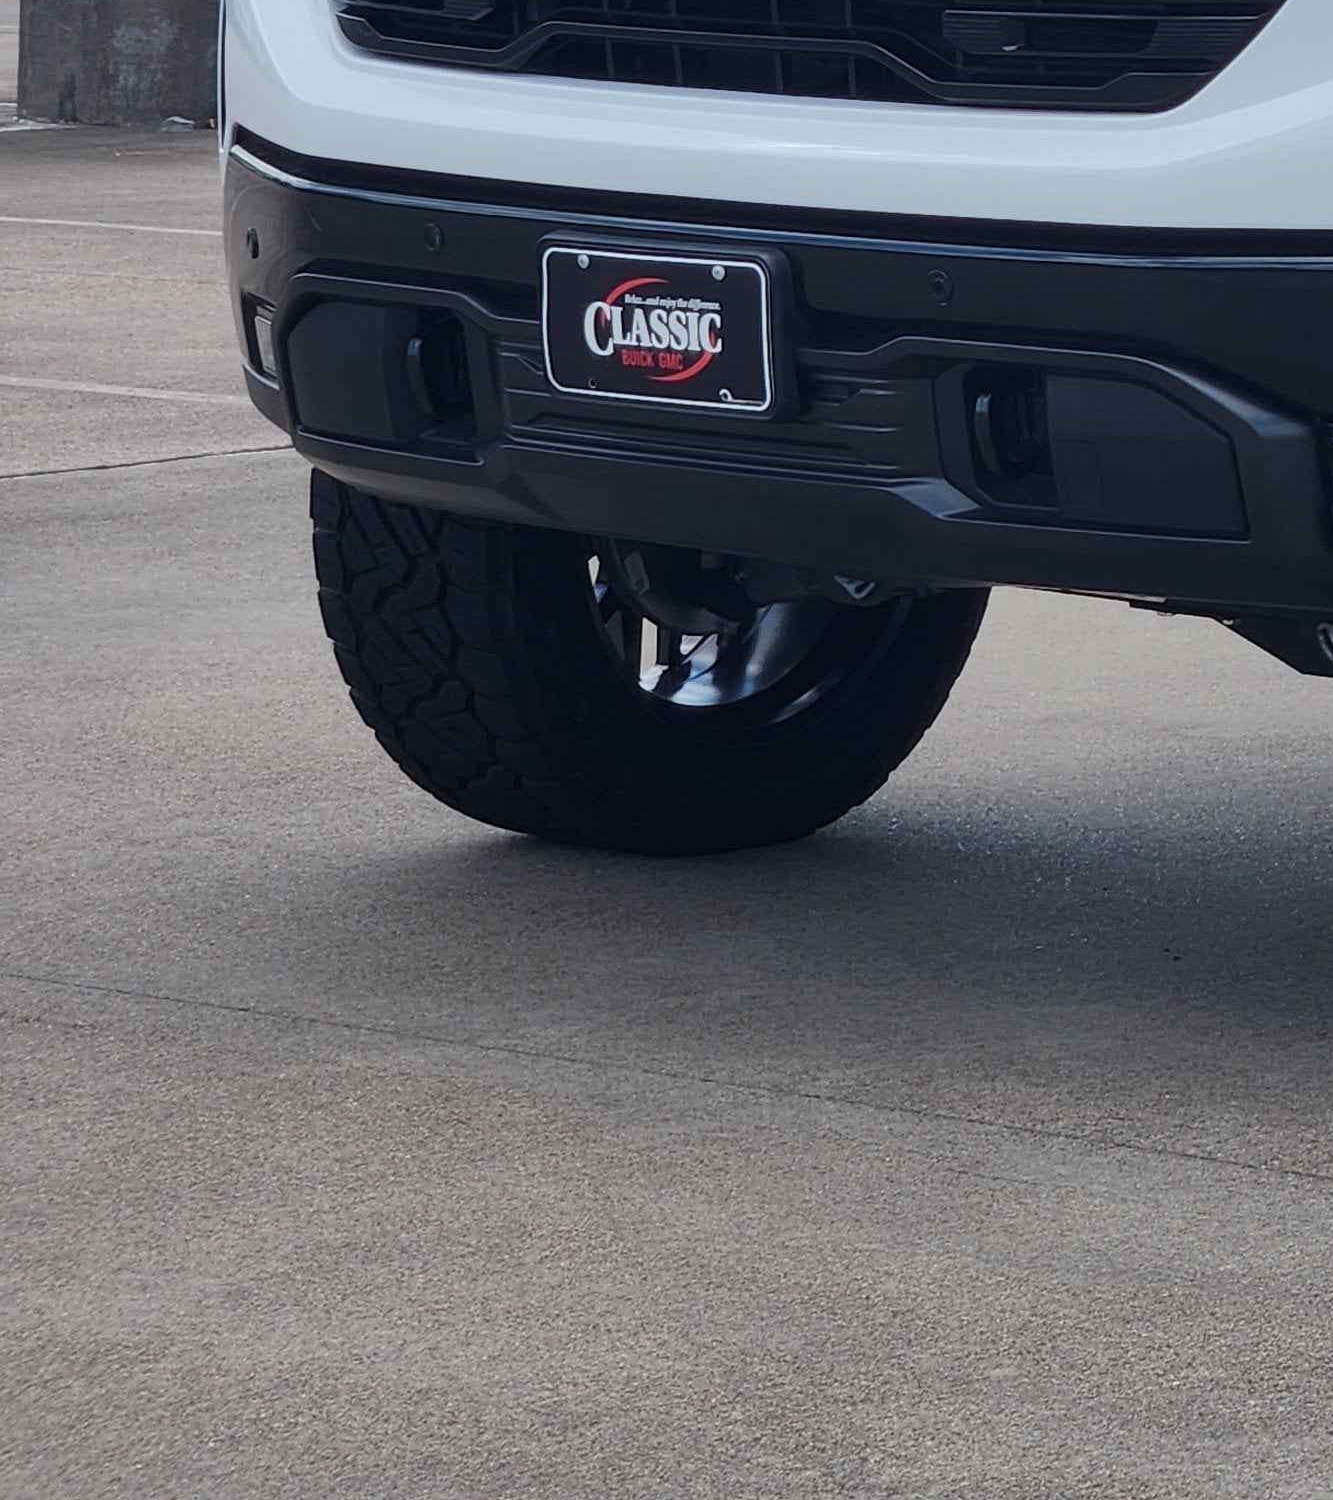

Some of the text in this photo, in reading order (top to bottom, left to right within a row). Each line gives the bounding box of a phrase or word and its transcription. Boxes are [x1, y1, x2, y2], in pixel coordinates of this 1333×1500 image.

[583, 301, 723, 356] CLASSIC
[622, 349, 683, 370] BUICK GMC
